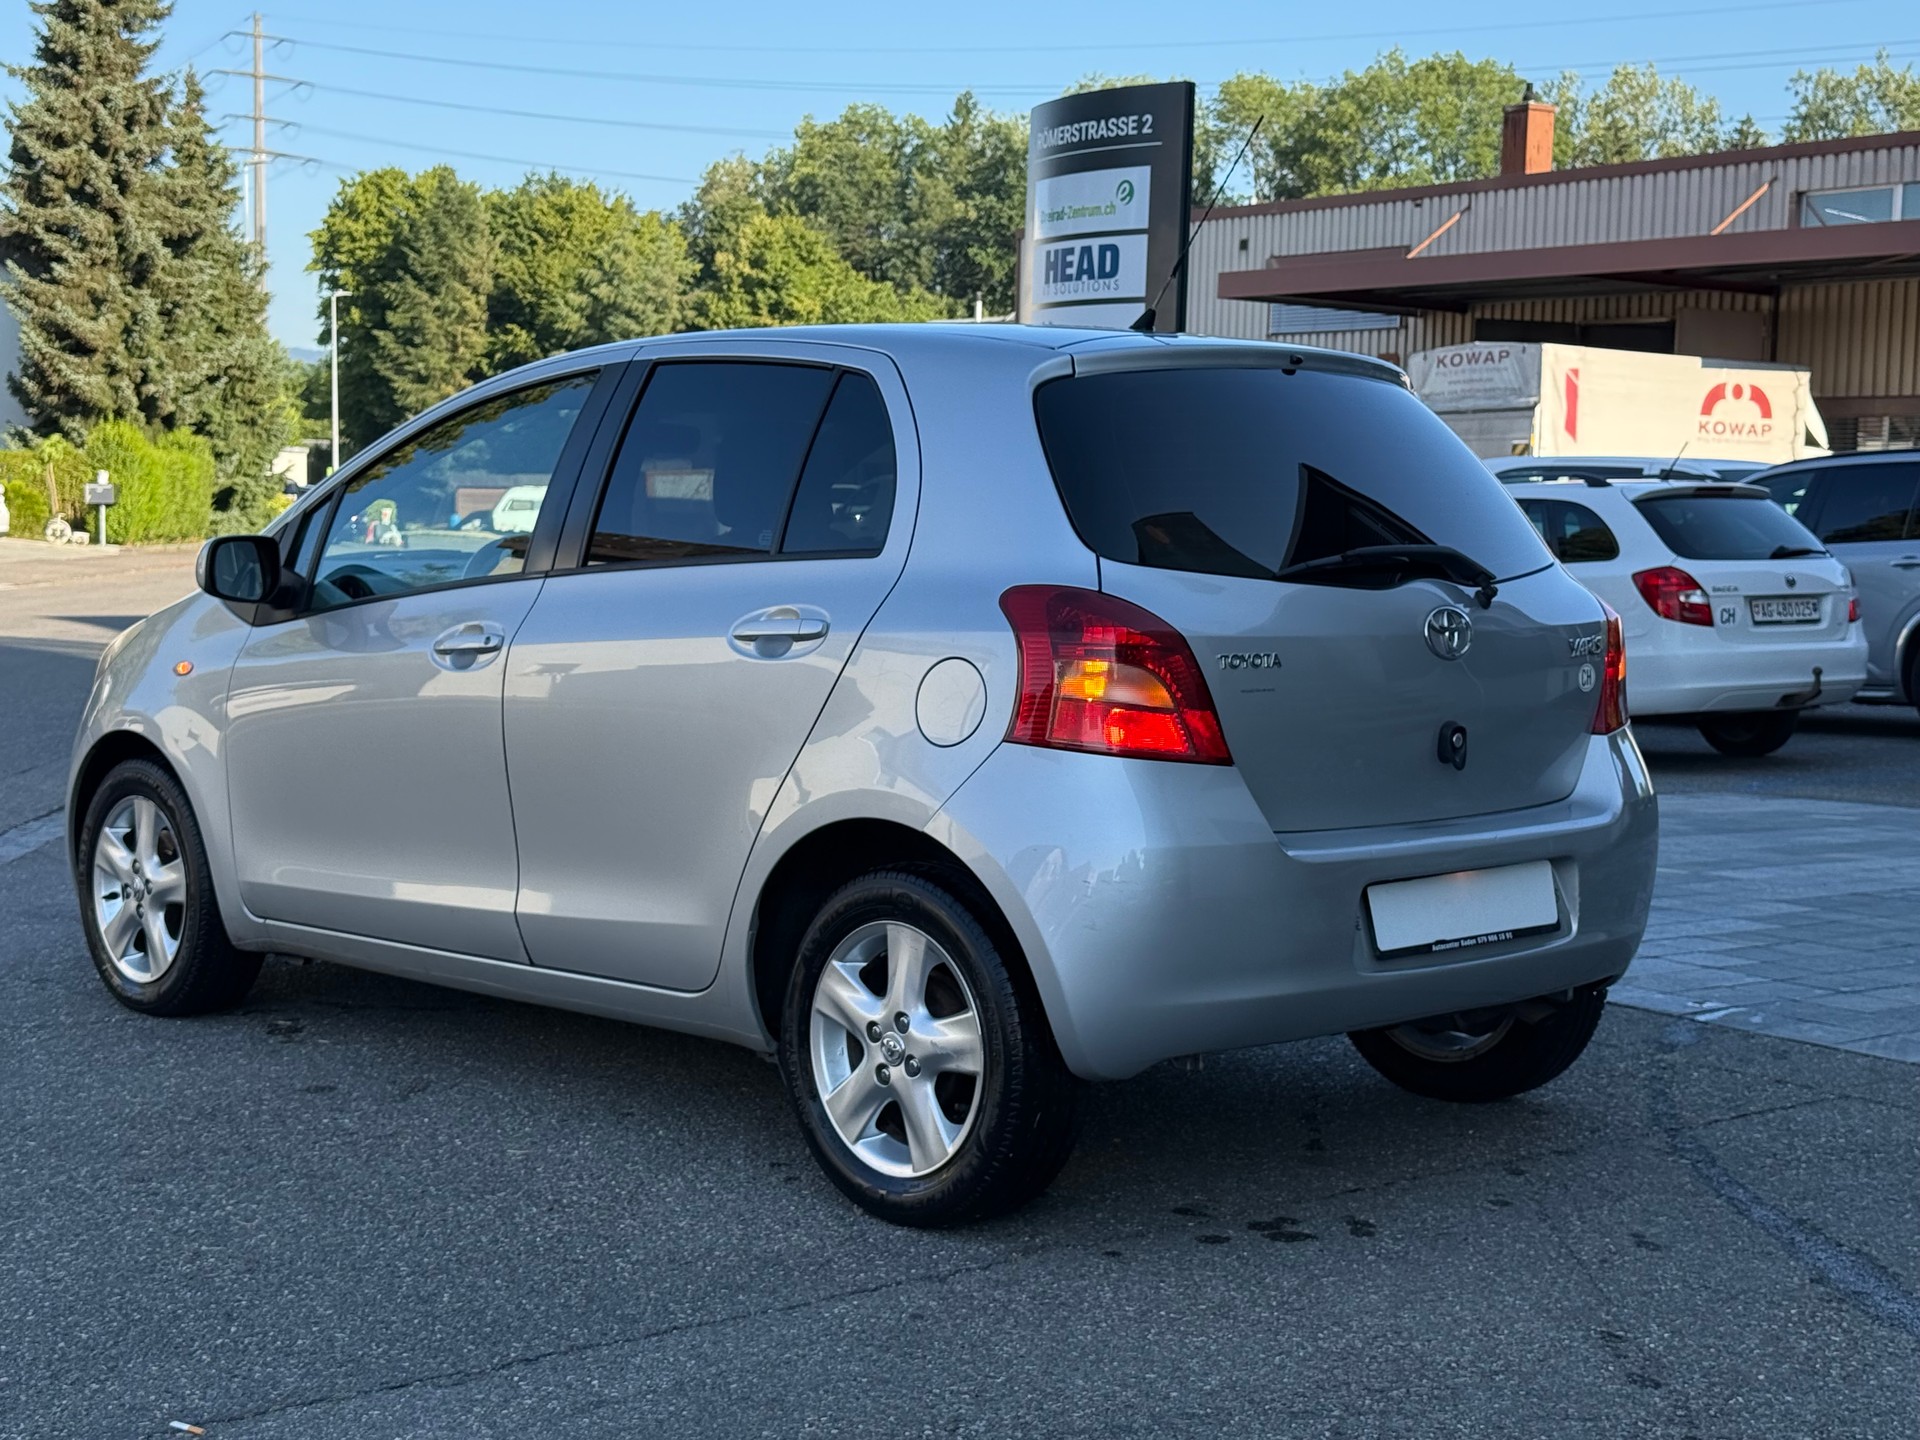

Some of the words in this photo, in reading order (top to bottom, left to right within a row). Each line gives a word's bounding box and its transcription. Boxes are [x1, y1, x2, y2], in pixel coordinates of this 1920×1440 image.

[1037, 115, 1139, 149] RÖMERSTRASSE
[1141, 114, 1153, 134] 2
[1044, 244, 1119, 285] HEAD
[1053, 279, 1120, 295] SOLUTIONS
[1436, 350, 1510, 368] KOWAP
[1699, 421, 1772, 437] KOWAP
[1720, 607, 1736, 624] CH
[1568, 635, 1604, 657] YARIS
[1216, 653, 1282, 670] TOYOTA
[1581, 668, 1591, 687] CH
